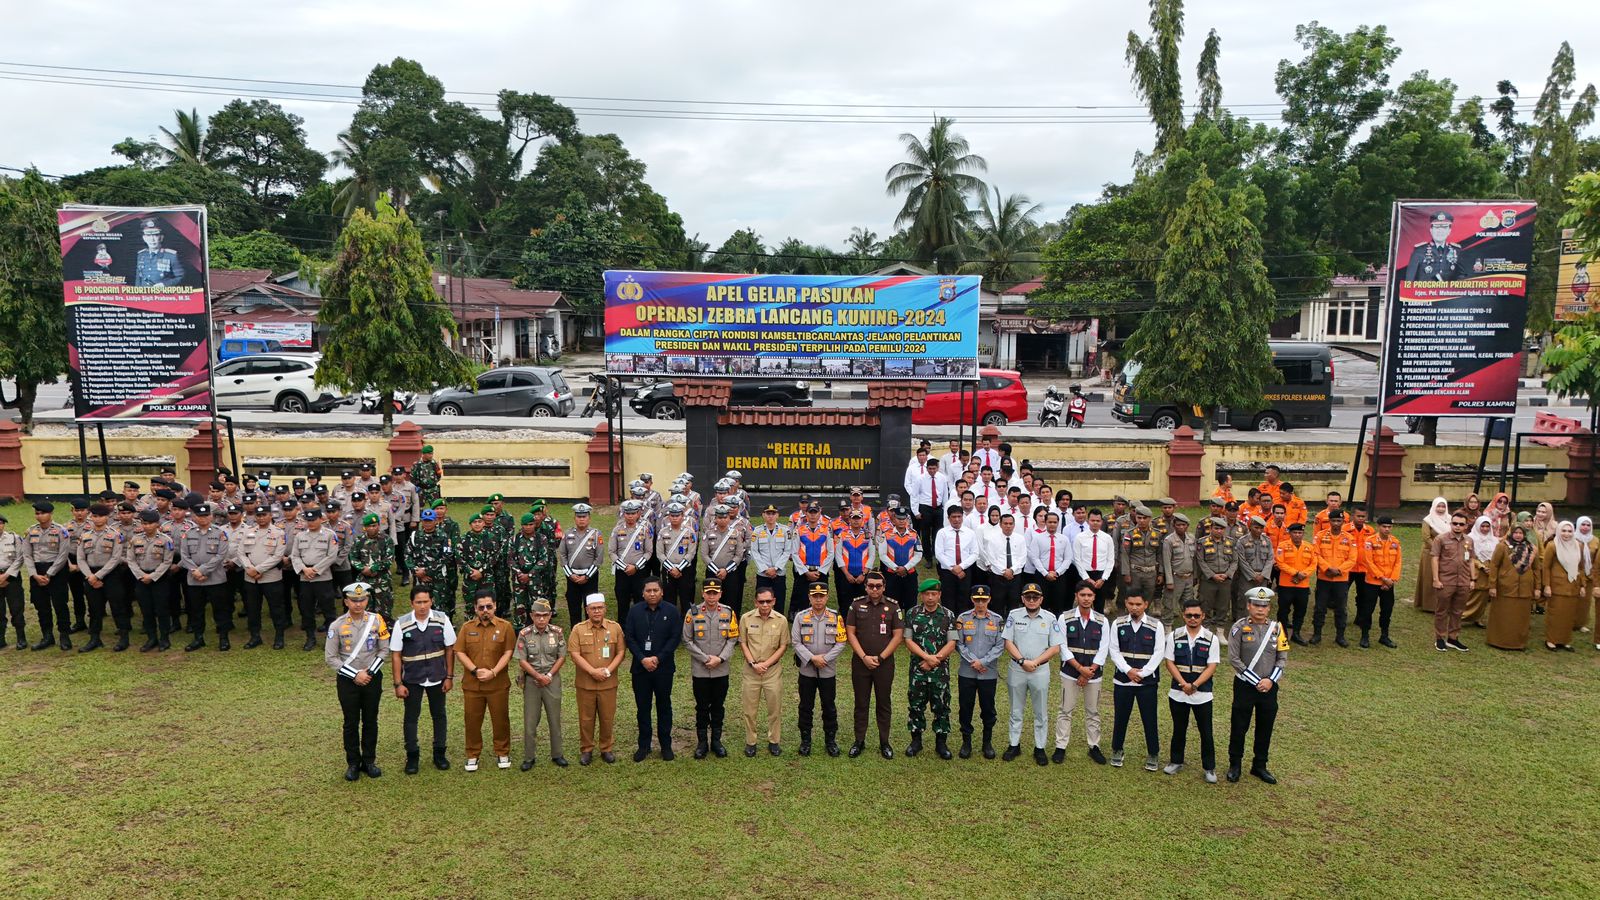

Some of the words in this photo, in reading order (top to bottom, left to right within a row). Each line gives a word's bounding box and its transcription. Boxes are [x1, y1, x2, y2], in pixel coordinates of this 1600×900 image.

[1404, 281, 1410, 289] 12
[1414, 281, 1448, 289] PROGRAM
[1450, 281, 1488, 289] PRIORITAS
[1490, 281, 1522, 289] KAPOLDA
[707, 286, 743, 301] APEL
[748, 287, 797, 302] GELAR
[801, 288, 874, 303] PASUKAN
[636, 306, 703, 322] OPERASI
[707, 308, 756, 323] ZEBRA
[760, 308, 832, 325] LANCANG
[838, 309, 946, 326] KUNING-2024
[620, 328, 650, 337] DALAM
[654, 329, 690, 338] RANGKA
[722, 331, 758, 339] KONDISI
[761, 332, 864, 340] KAMSELTIBCARLANTAS
[655, 341, 699, 349] PRESIDEN
[702, 342, 720, 350] DAN
[723, 342, 751, 350] WAKIL
[754, 343, 797, 351] PRESIDEN
[767, 443, 831, 455] “BEKERJA
[726, 457, 778, 469] DENGAN
[783, 458, 810, 469] HATI
[816, 458, 871, 470] NURANI”
